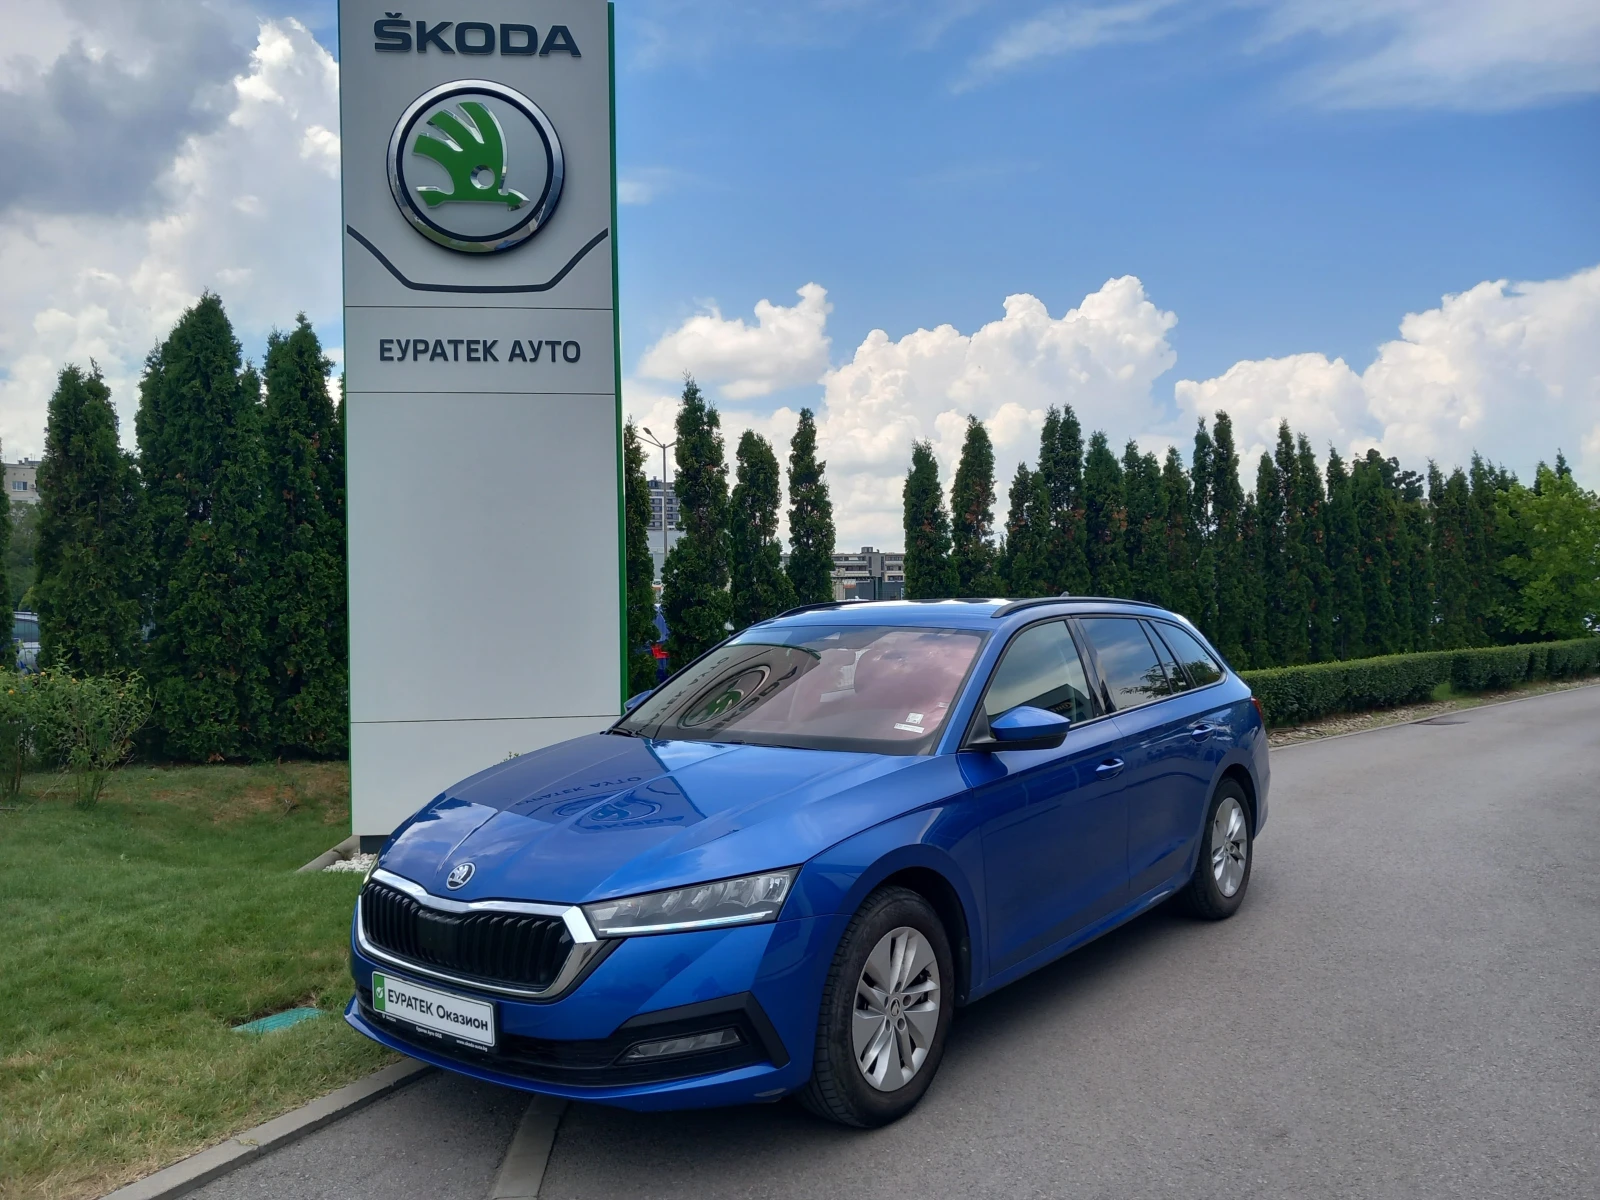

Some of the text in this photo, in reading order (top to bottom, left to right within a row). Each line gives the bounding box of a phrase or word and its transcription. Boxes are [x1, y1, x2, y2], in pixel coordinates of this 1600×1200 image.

[373, 12, 582, 57] ŠKODA
[379, 338, 581, 363] ЕУРАТЕК АУТО
[387, 989, 488, 1031] ЕУРАТЕК Оказион
